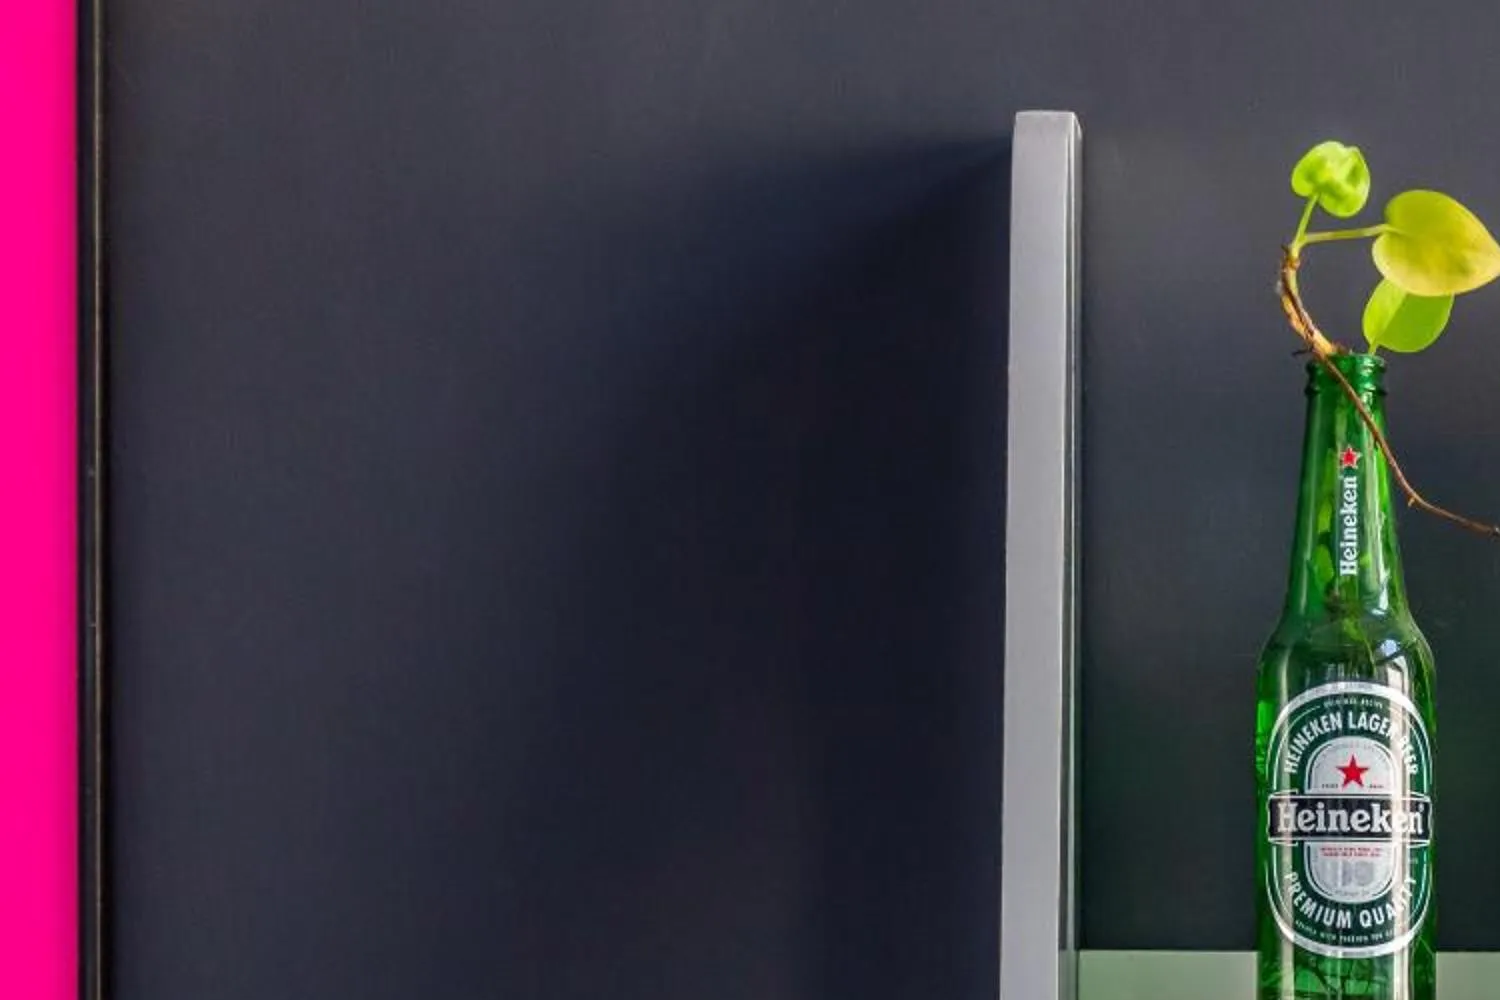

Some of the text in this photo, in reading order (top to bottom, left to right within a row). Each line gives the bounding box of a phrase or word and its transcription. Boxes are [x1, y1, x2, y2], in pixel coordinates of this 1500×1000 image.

[1340, 476, 1359, 577] Heineken
[1283, 711, 1343, 774] HEINEKEN
[1276, 801, 1424, 835] Heineken
[1284, 871, 1417, 929] PREMIUM QUAITY
